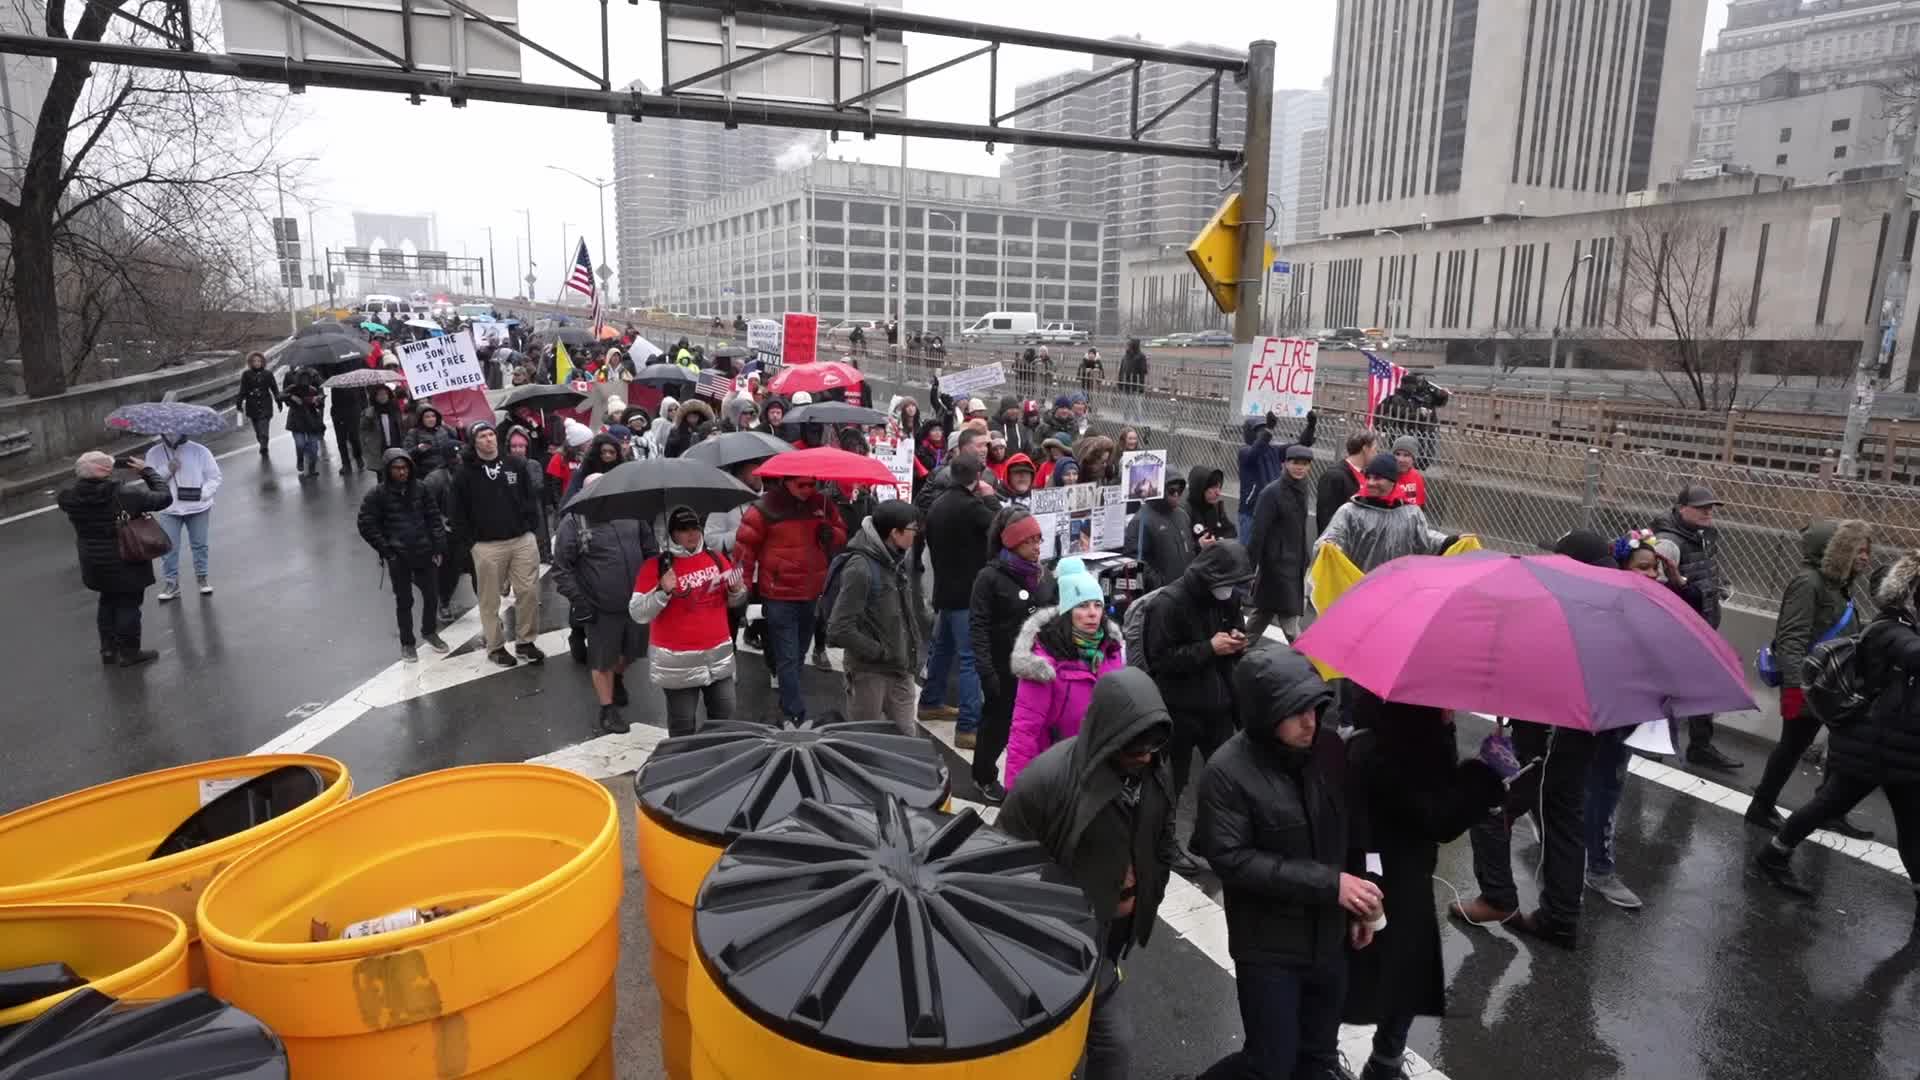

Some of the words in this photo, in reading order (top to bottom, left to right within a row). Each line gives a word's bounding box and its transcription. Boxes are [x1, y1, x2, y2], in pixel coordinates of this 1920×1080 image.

[402, 341, 429, 354] WHOM
[438, 335, 457, 346] THE
[425, 348, 444, 360] SON
[1260, 339, 1315, 368] FIRE
[416, 361, 434, 373] SET
[441, 354, 466, 367] FREE
[437, 368, 449, 379] IS
[1247, 364, 1314, 395] FAUCI
[414, 381, 439, 395] FREE
[446, 372, 481, 387] INDEED
